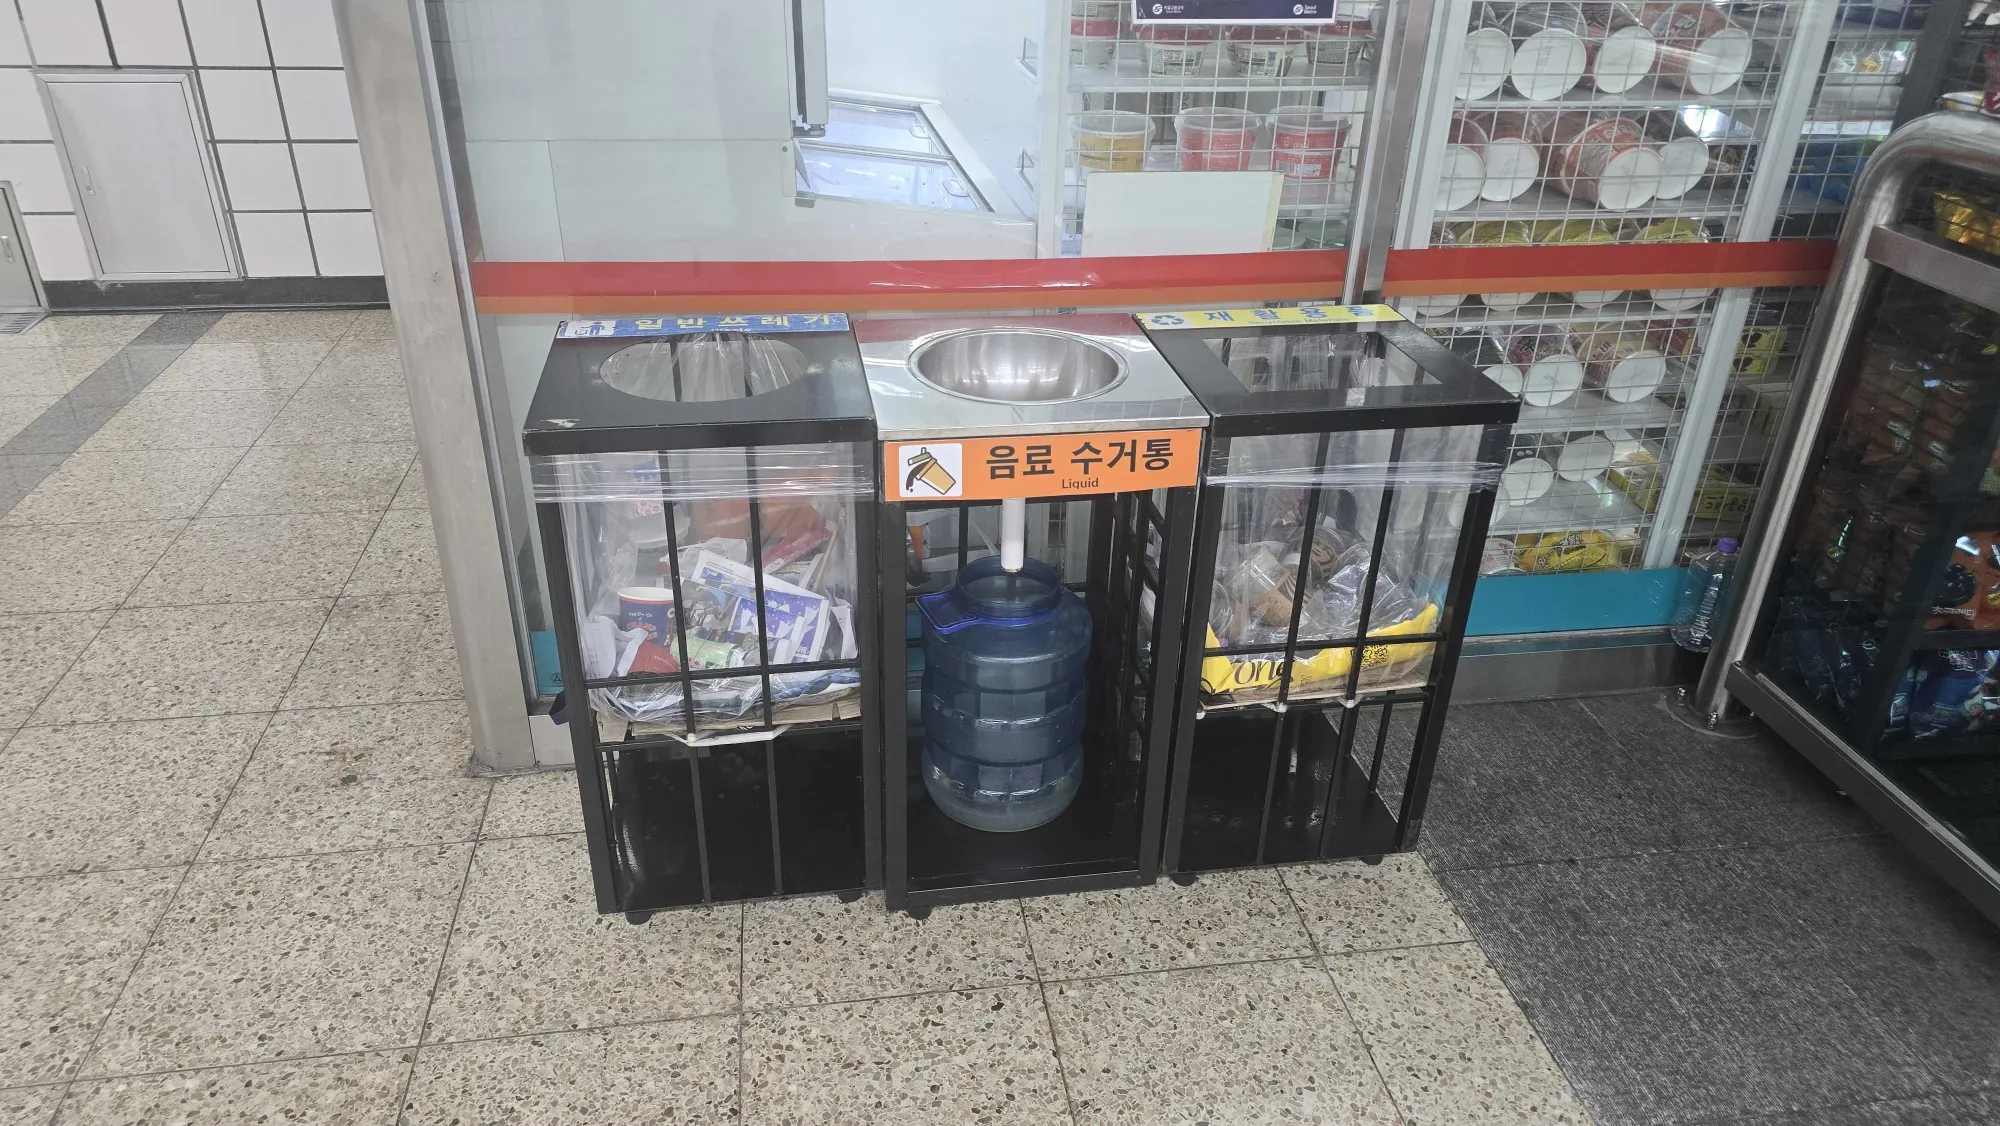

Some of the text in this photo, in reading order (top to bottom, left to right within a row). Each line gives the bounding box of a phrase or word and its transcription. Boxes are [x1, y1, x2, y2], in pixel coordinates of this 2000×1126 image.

[986, 438, 1174, 480] 음료 수거통
[1062, 477, 1099, 490] Liquid
